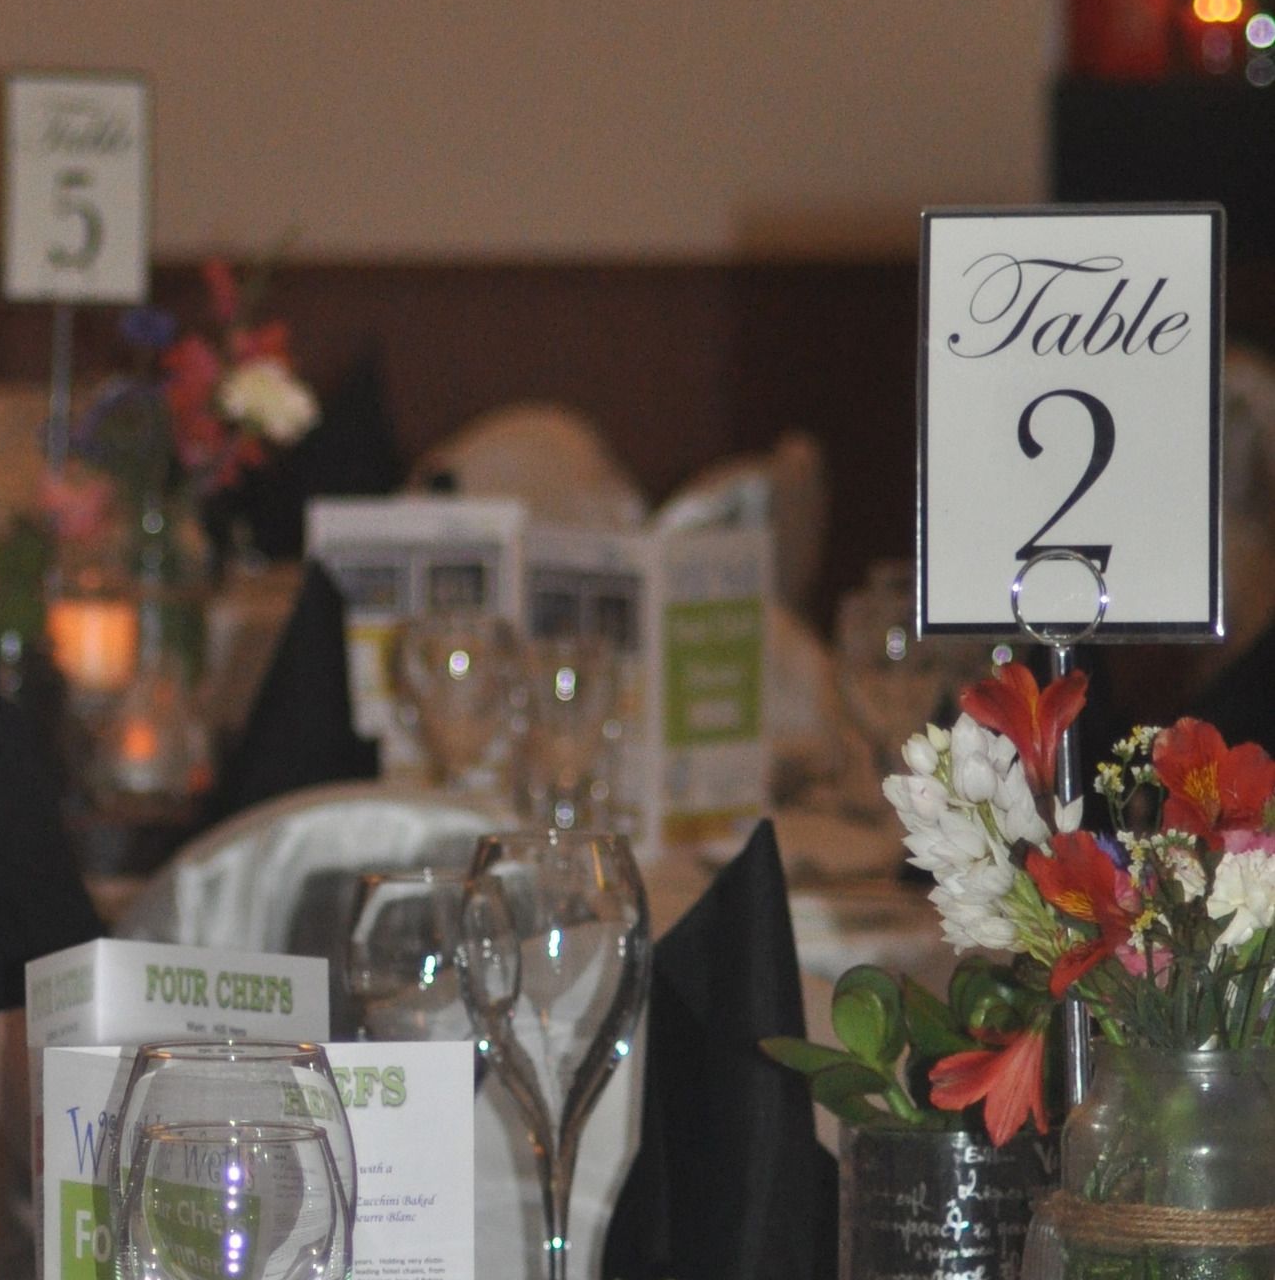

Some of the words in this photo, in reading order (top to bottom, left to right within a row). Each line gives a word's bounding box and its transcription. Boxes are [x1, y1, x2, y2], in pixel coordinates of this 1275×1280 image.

[46, 166, 106, 272] 5
[948, 253, 1192, 358] Table
[1015, 388, 1116, 575] 2
[146, 964, 209, 1007] FOUR
[216, 971, 293, 1015] CHEFS
[360, 1161, 384, 1174] with
[386, 1165, 393, 1174] a
[357, 1193, 399, 1207] Zucchini
[402, 1193, 437, 1207] Baked
[386, 1210, 417, 1222] Blanc
[355, 1267, 380, 1276] leading
[382, 1267, 401, 1275] hotel
[428, 1266, 446, 1274] from
